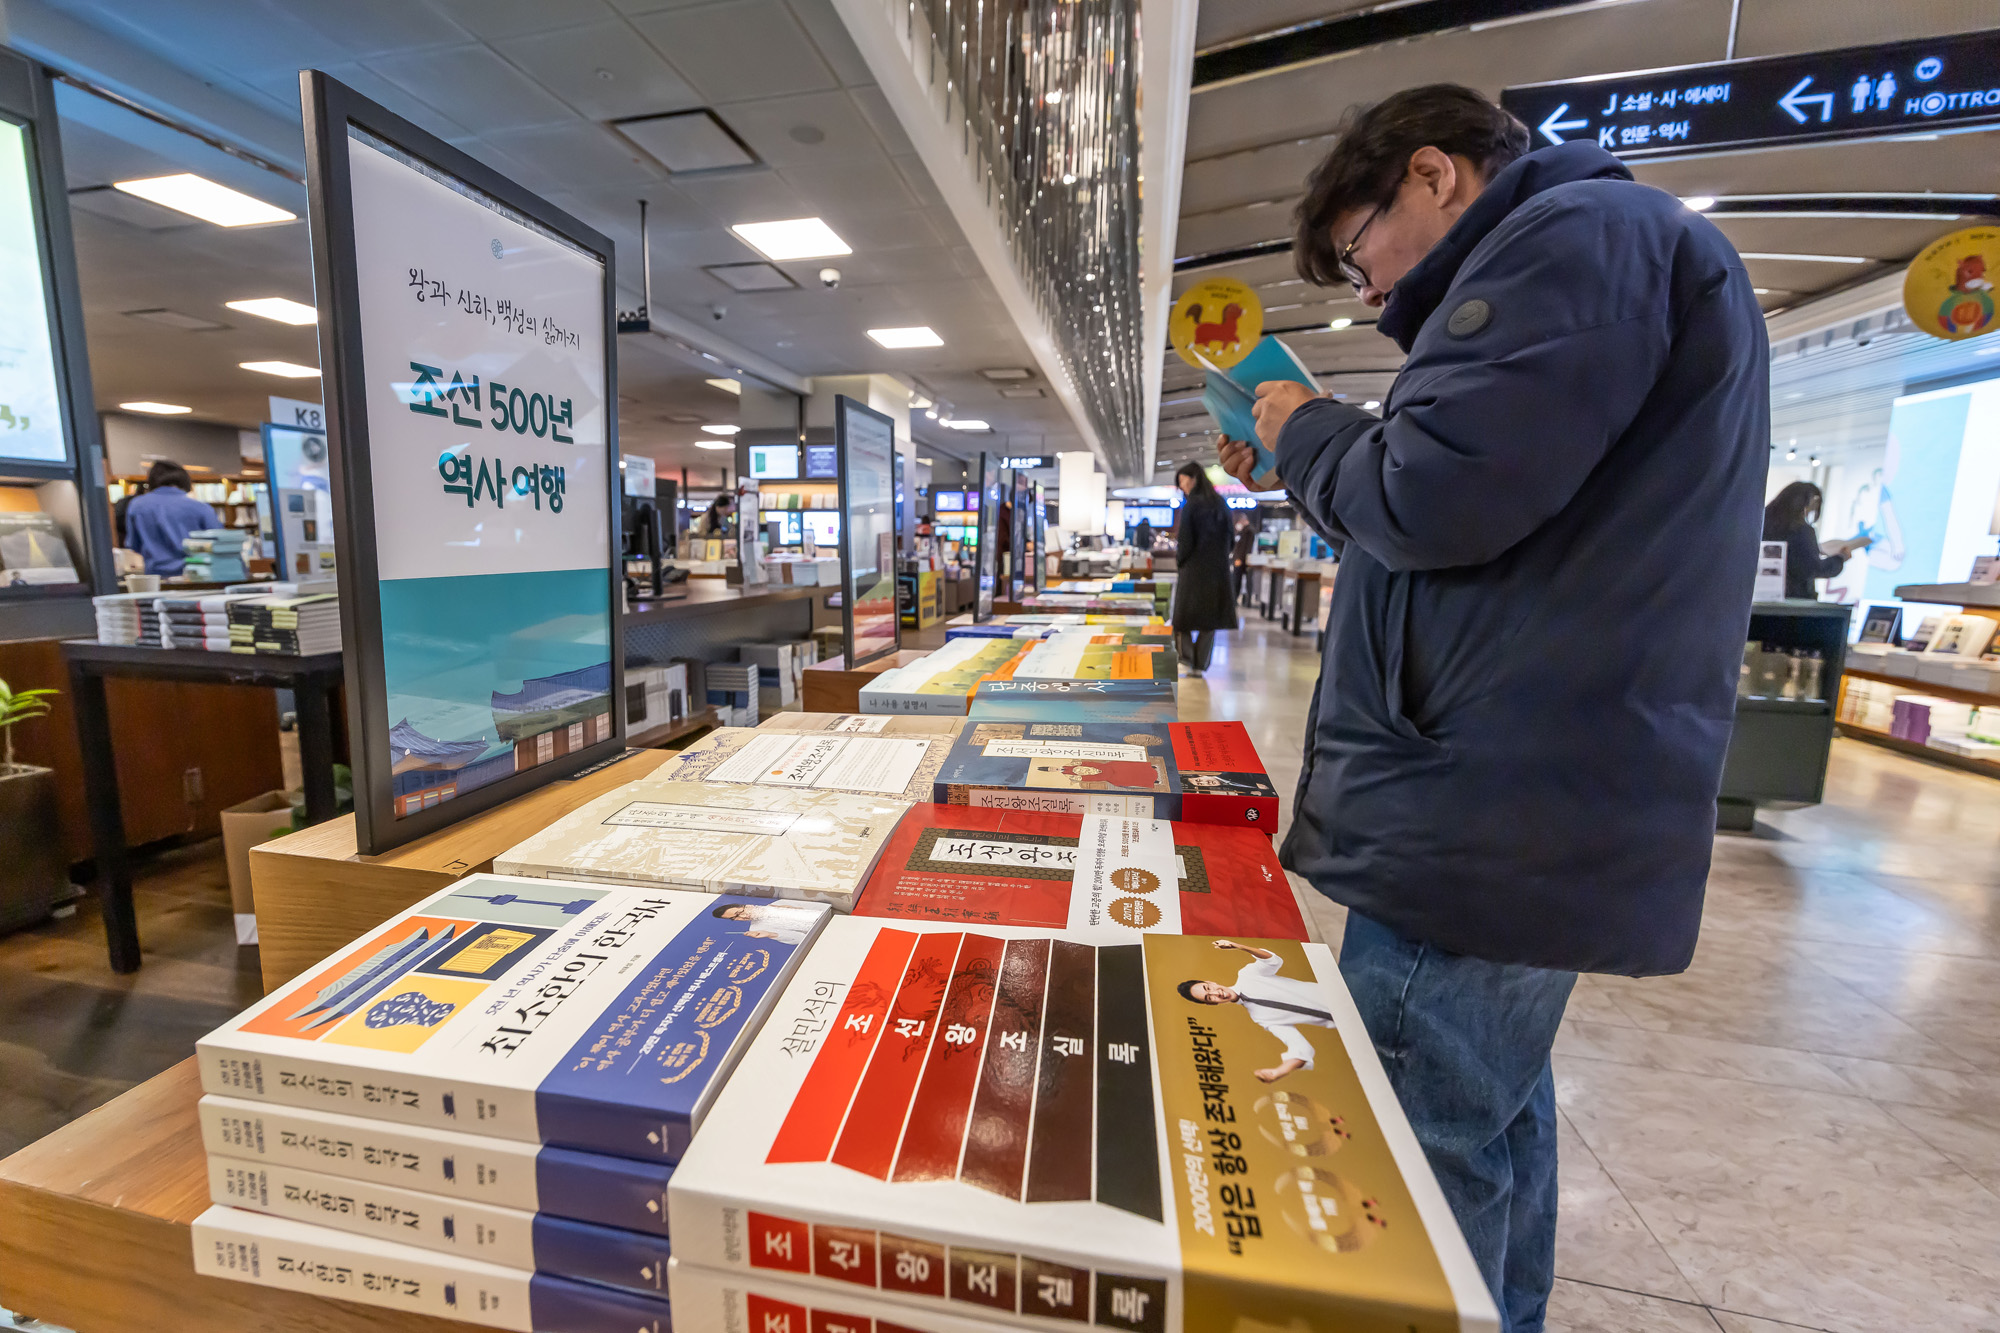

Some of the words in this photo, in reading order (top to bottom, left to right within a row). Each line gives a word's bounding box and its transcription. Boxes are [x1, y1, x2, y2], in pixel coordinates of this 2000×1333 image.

[1601, 93, 1618, 116] J
[1599, 125, 1618, 149] K
[1620, 120, 1691, 145] 인문·역사
[409, 268, 451, 306] 왕과
[409, 361, 483, 429] 조선
[490, 381, 574, 445] 500년
[438, 452, 507, 509] 역사
[511, 463, 566, 514] 여행
[870, 699, 877, 708] 나
[881, 699, 899, 709] 사용
[903, 700, 928, 710] 설명서
[787, 738, 839, 781] 조선왕조실록
[997, 747, 1130, 759] 조선왕조실록
[981, 794, 1075, 812] 조선왕조실록
[1088, 909, 1100, 926] 탄탄한
[1123, 902, 1132, 921] 2017년
[480, 952, 609, 1059] 최소한의
[592, 898, 672, 948] 한국사
[485, 998, 509, 1016] 5천
[503, 989, 521, 999] 년
[517, 957, 552, 987] 역사가
[548, 938, 580, 960] 단숨에
[654, 1013, 679, 1036] 독자가
[672, 992, 695, 1013] 선택한
[688, 979, 706, 993] 역사
[779, 980, 847, 1059] 설민석의
[590, 1034, 614, 1054] 책이
[608, 1013, 631, 1033] 역사
[596, 1048, 622, 1072] 역사
[615, 1019, 646, 1049] 공부가
[640, 1008, 656, 1018] 더
[650, 990, 670, 1007] 쉽고
[844, 1013, 1139, 1065] 조선왕조실록
[280, 1071, 355, 1098] 최소한의
[363, 1085, 420, 1109] 한국사
[1187, 1016, 1237, 1124] 존재해왔다!”
[280, 1131, 355, 1159] 최소한의
[363, 1146, 420, 1172] 한국사
[1208, 1127, 1247, 1176] 항상
[284, 1184, 356, 1216] 최소한의
[364, 1202, 420, 1230] 한국사
[1184, 1154, 1215, 1237] 2000만의
[1220, 1183, 1263, 1256] “답은
[277, 1256, 353, 1287] 최소한의
[363, 1272, 420, 1298] 한국사
[765, 1231, 1149, 1323] 조선왕조실록
